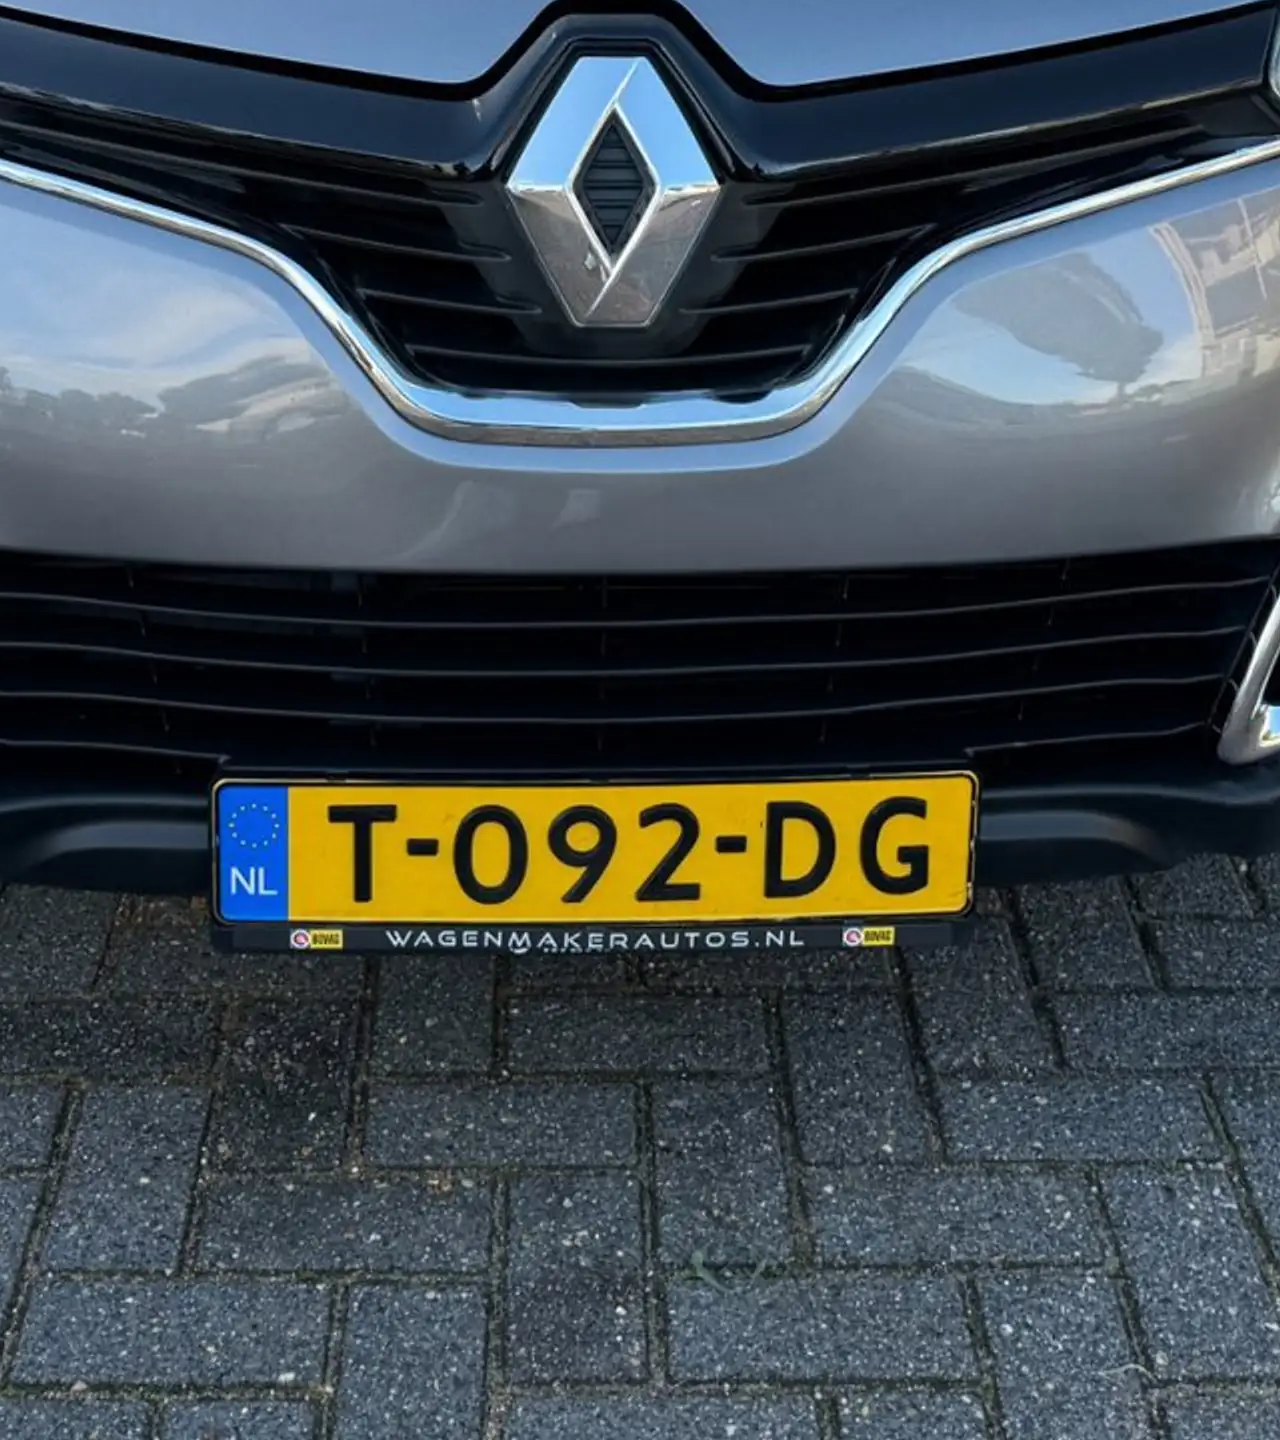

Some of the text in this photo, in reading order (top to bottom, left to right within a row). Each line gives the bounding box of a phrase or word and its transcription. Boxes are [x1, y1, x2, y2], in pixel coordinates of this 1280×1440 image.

[327, 796, 929, 905] T-092-DG
[230, 866, 279, 896] NL
[385, 928, 805, 953] WAGENMAKERAUTOS.NL
